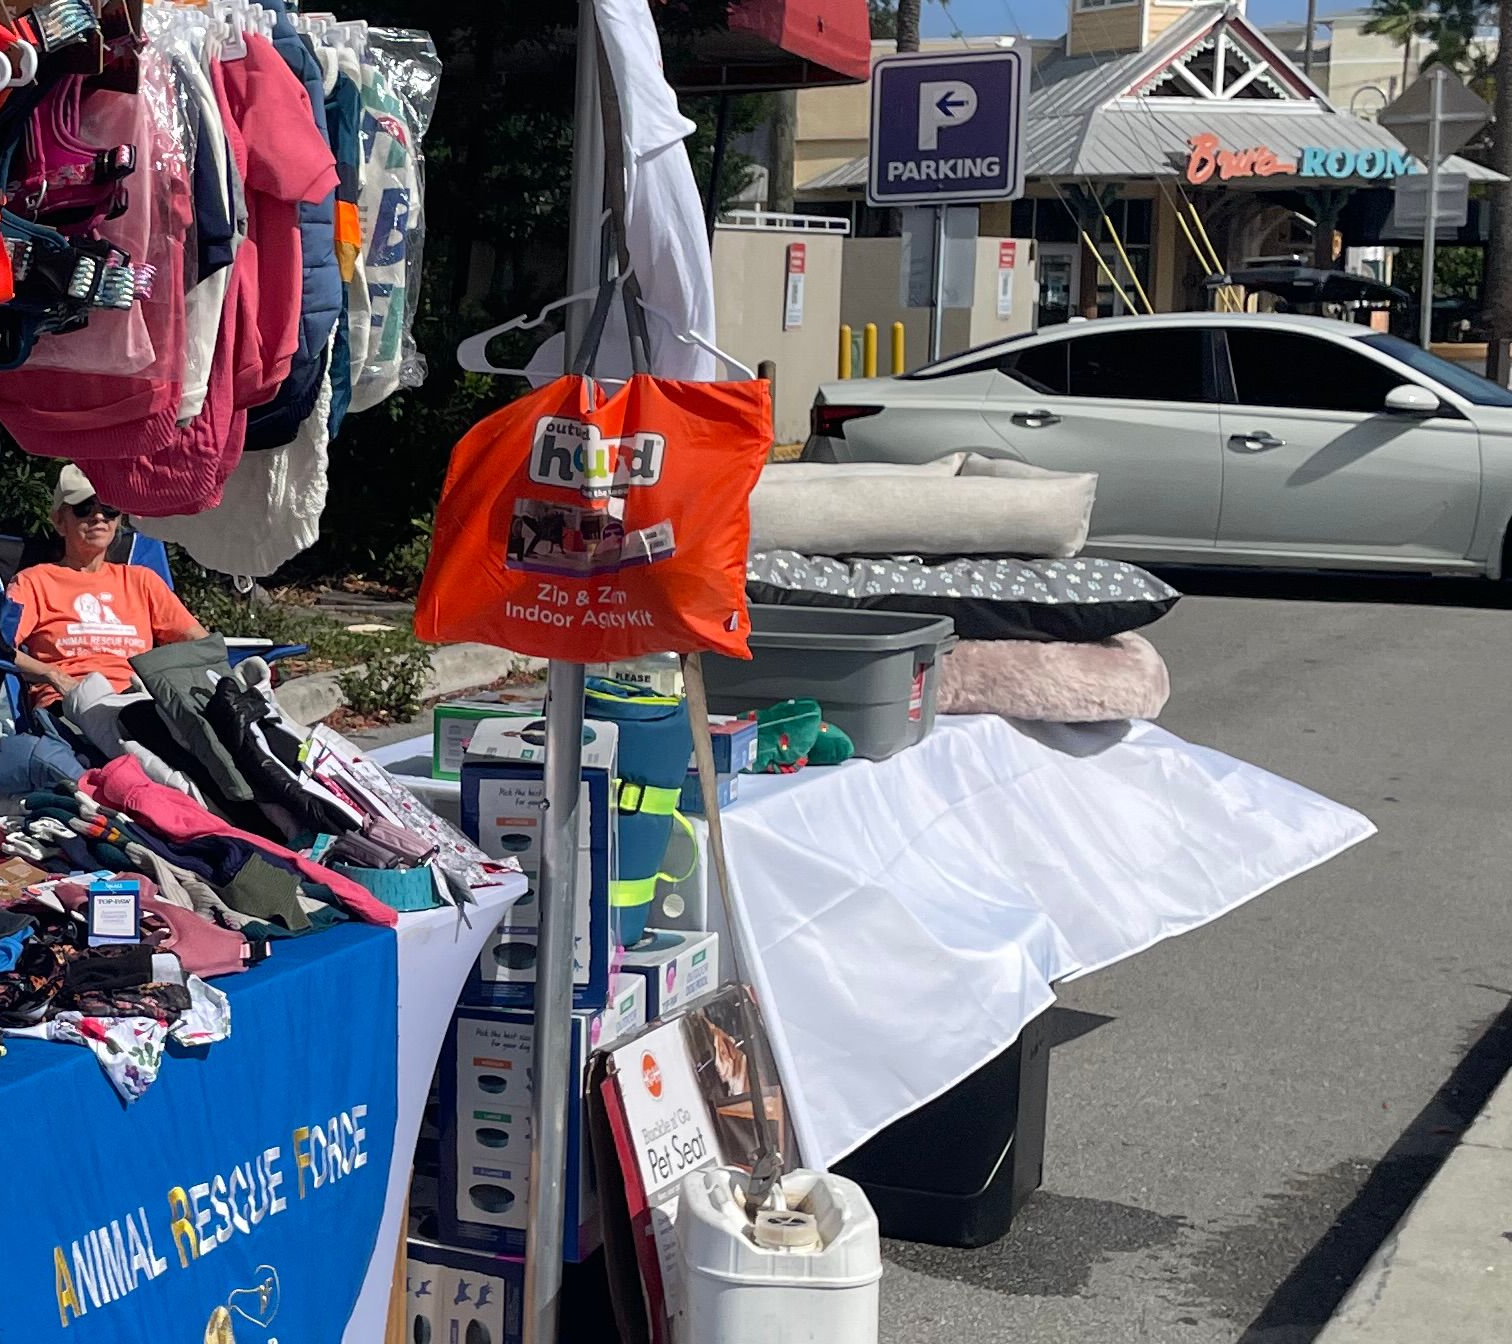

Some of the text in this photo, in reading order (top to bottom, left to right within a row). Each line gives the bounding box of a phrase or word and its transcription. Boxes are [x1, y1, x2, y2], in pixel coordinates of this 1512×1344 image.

[918, 80, 978, 151] P
[888, 156, 1001, 183] PARKING
[1300, 146, 1417, 178] ROOM
[537, 583, 568, 607] Zip
[575, 590, 590, 606] &
[505, 601, 574, 628] Indoor
[627, 609, 655, 627] Kit
[677, 1107, 692, 1126] Go
[647, 1127, 707, 1184] Pet Seat
[54, 1104, 368, 1328] ANIMAL RESCUE FORCE
